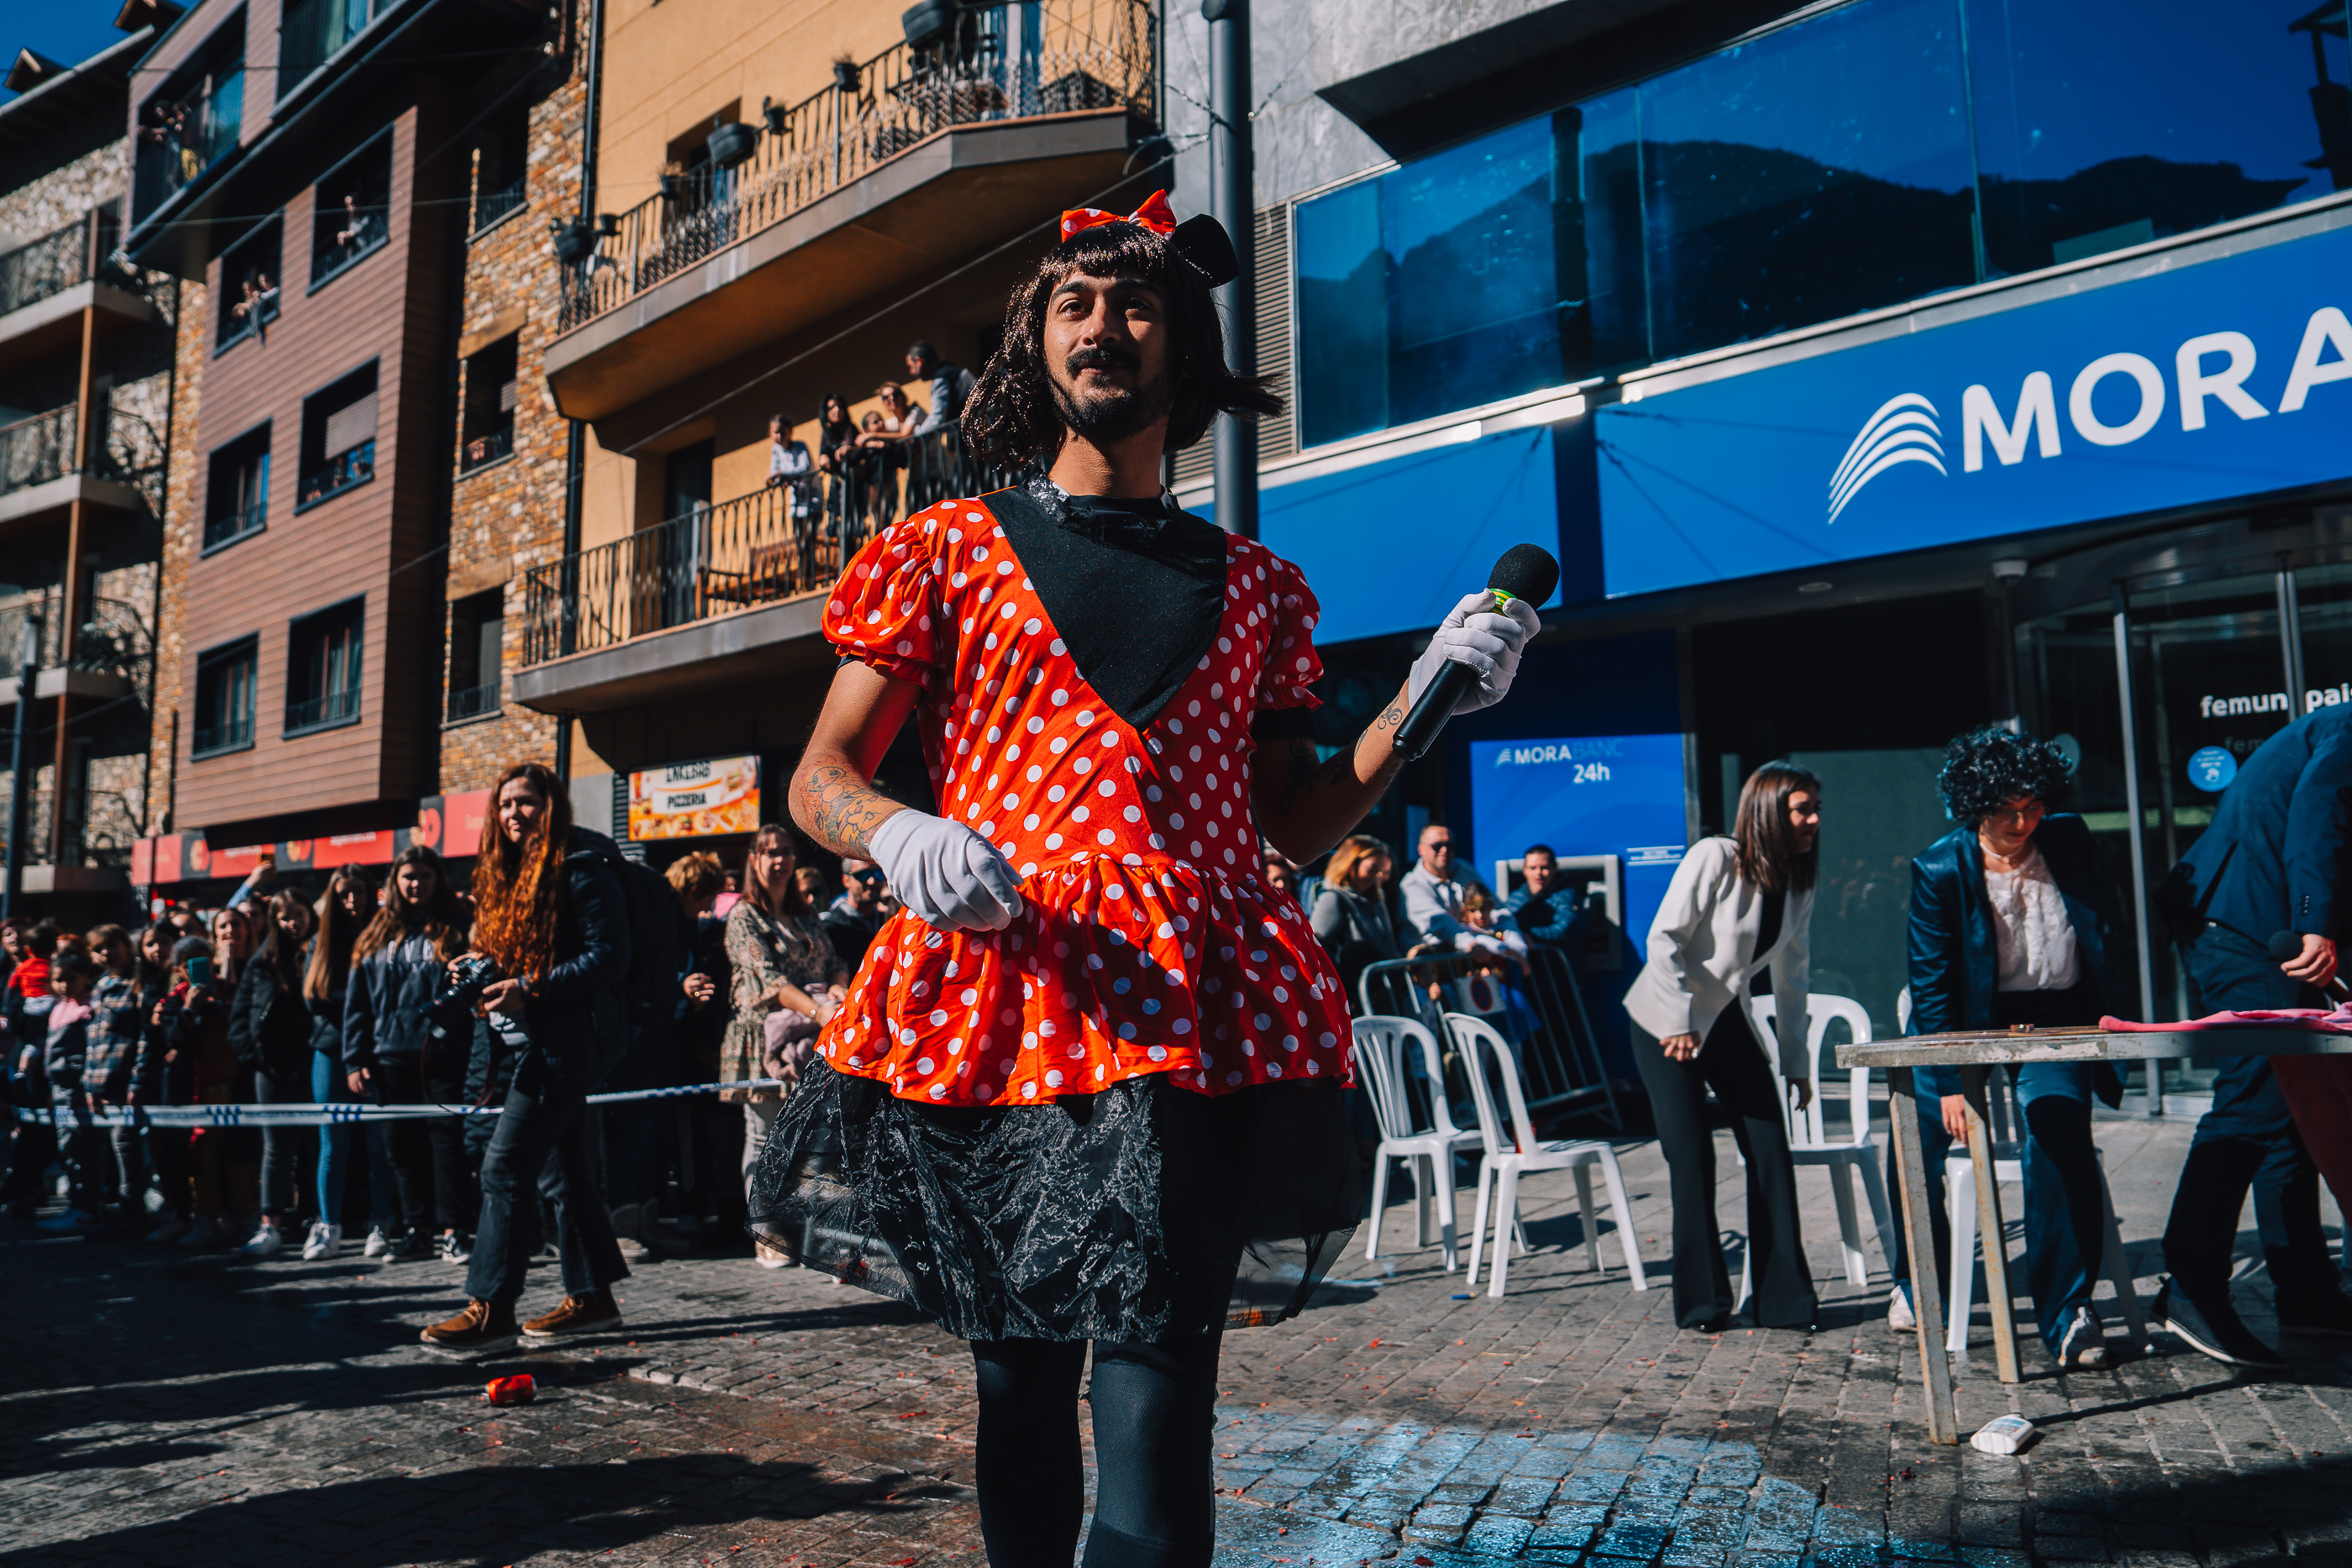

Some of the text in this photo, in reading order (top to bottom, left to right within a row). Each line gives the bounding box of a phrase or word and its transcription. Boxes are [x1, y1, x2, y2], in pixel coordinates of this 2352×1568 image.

[1962, 306, 2352, 473] MORA
[2200, 683, 2352, 719] femun pai
[1572, 762, 1610, 784] 24h
[667, 793, 706, 808] PIZZERIA
